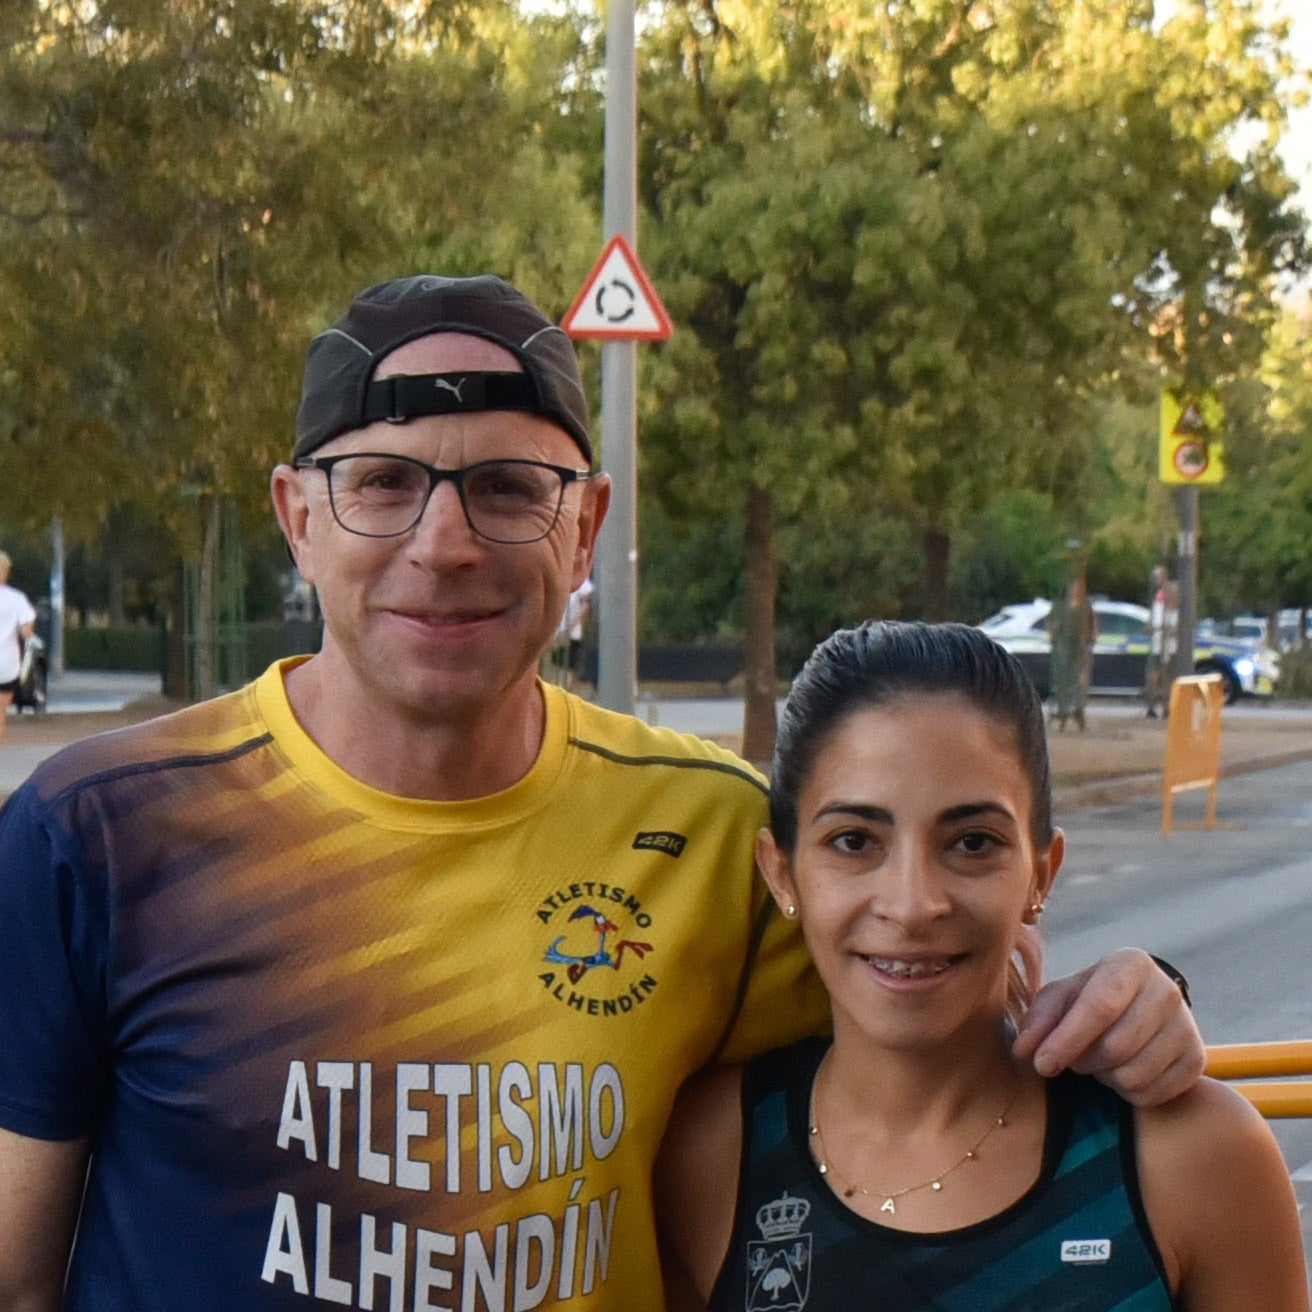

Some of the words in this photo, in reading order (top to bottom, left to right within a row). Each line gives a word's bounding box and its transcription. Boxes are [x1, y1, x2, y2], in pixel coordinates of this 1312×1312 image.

[537, 882, 652, 929] ATLETISMO
[538, 971, 658, 1016] ALHENDÍN
[276, 1060, 626, 1194] ATLETISMO
[1064, 1243, 1107, 1256] 42K
